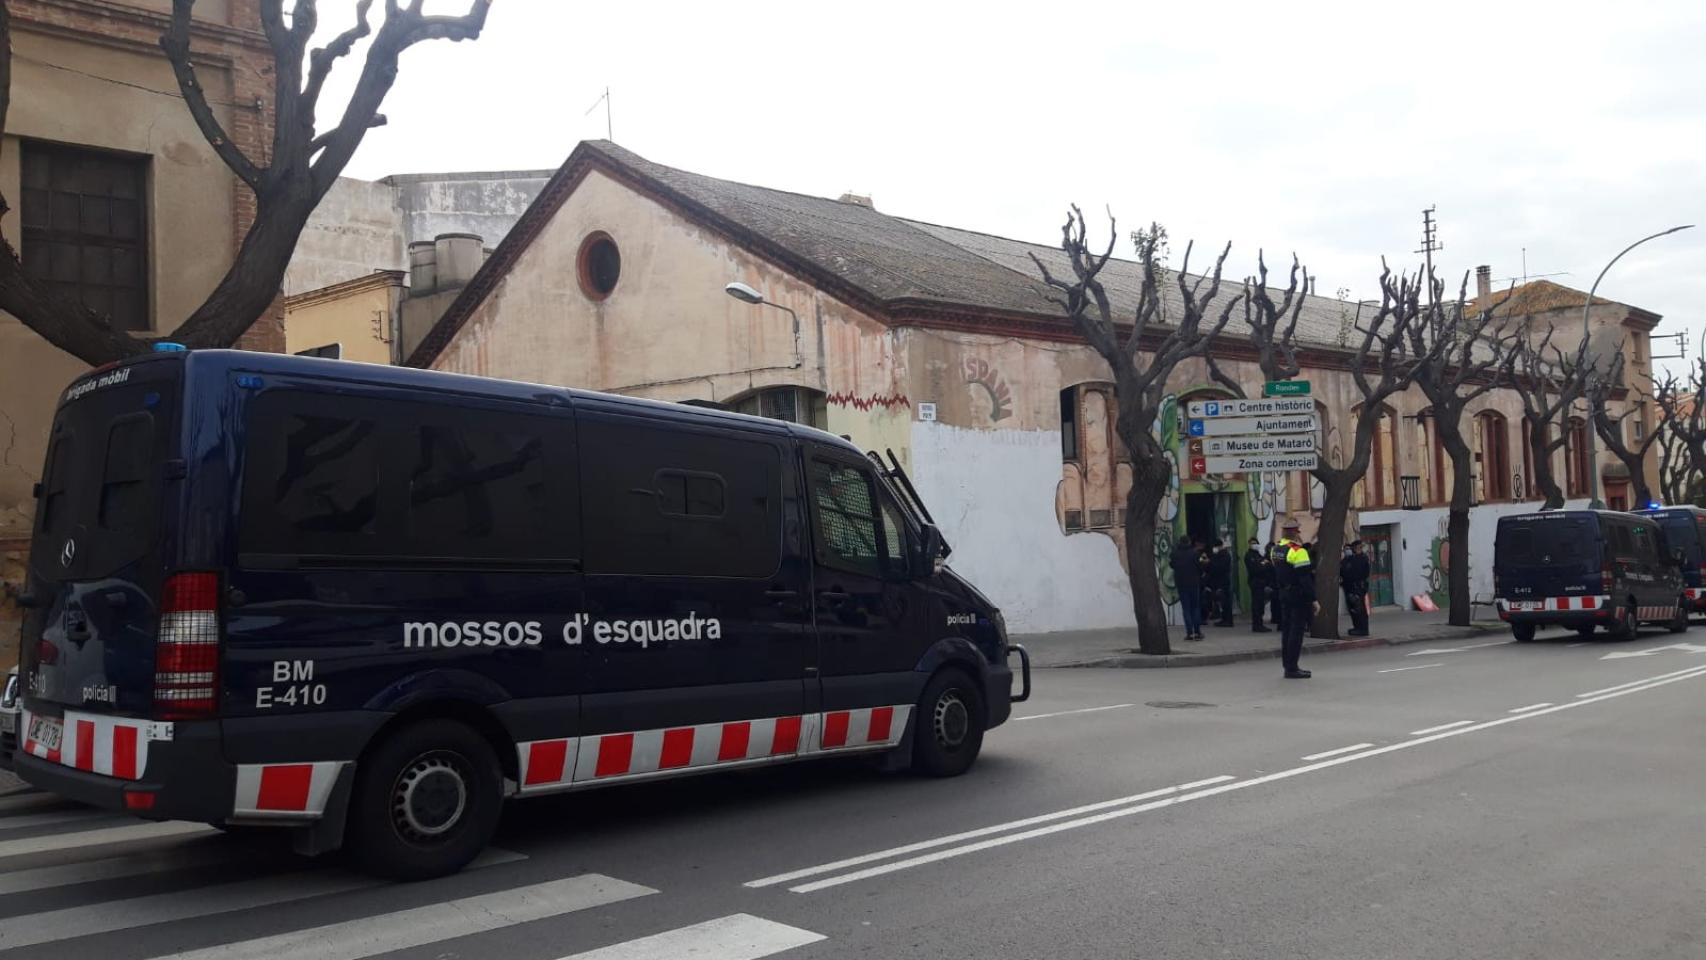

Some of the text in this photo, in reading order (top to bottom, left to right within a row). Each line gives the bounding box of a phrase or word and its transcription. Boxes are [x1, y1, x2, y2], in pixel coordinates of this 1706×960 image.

[1239, 402, 1272, 413] Centre
[1275, 400, 1312, 411] històric
[1256, 418, 1312, 431] Ajuntament
[1226, 438, 1312, 451] Museu de Mataró
[1239, 456, 1315, 469] Zona comercial
[403, 610, 721, 649] mossos d'esquadra
[272, 659, 314, 682] BM
[82, 684, 108, 702] policia
[255, 684, 327, 708] E-410
